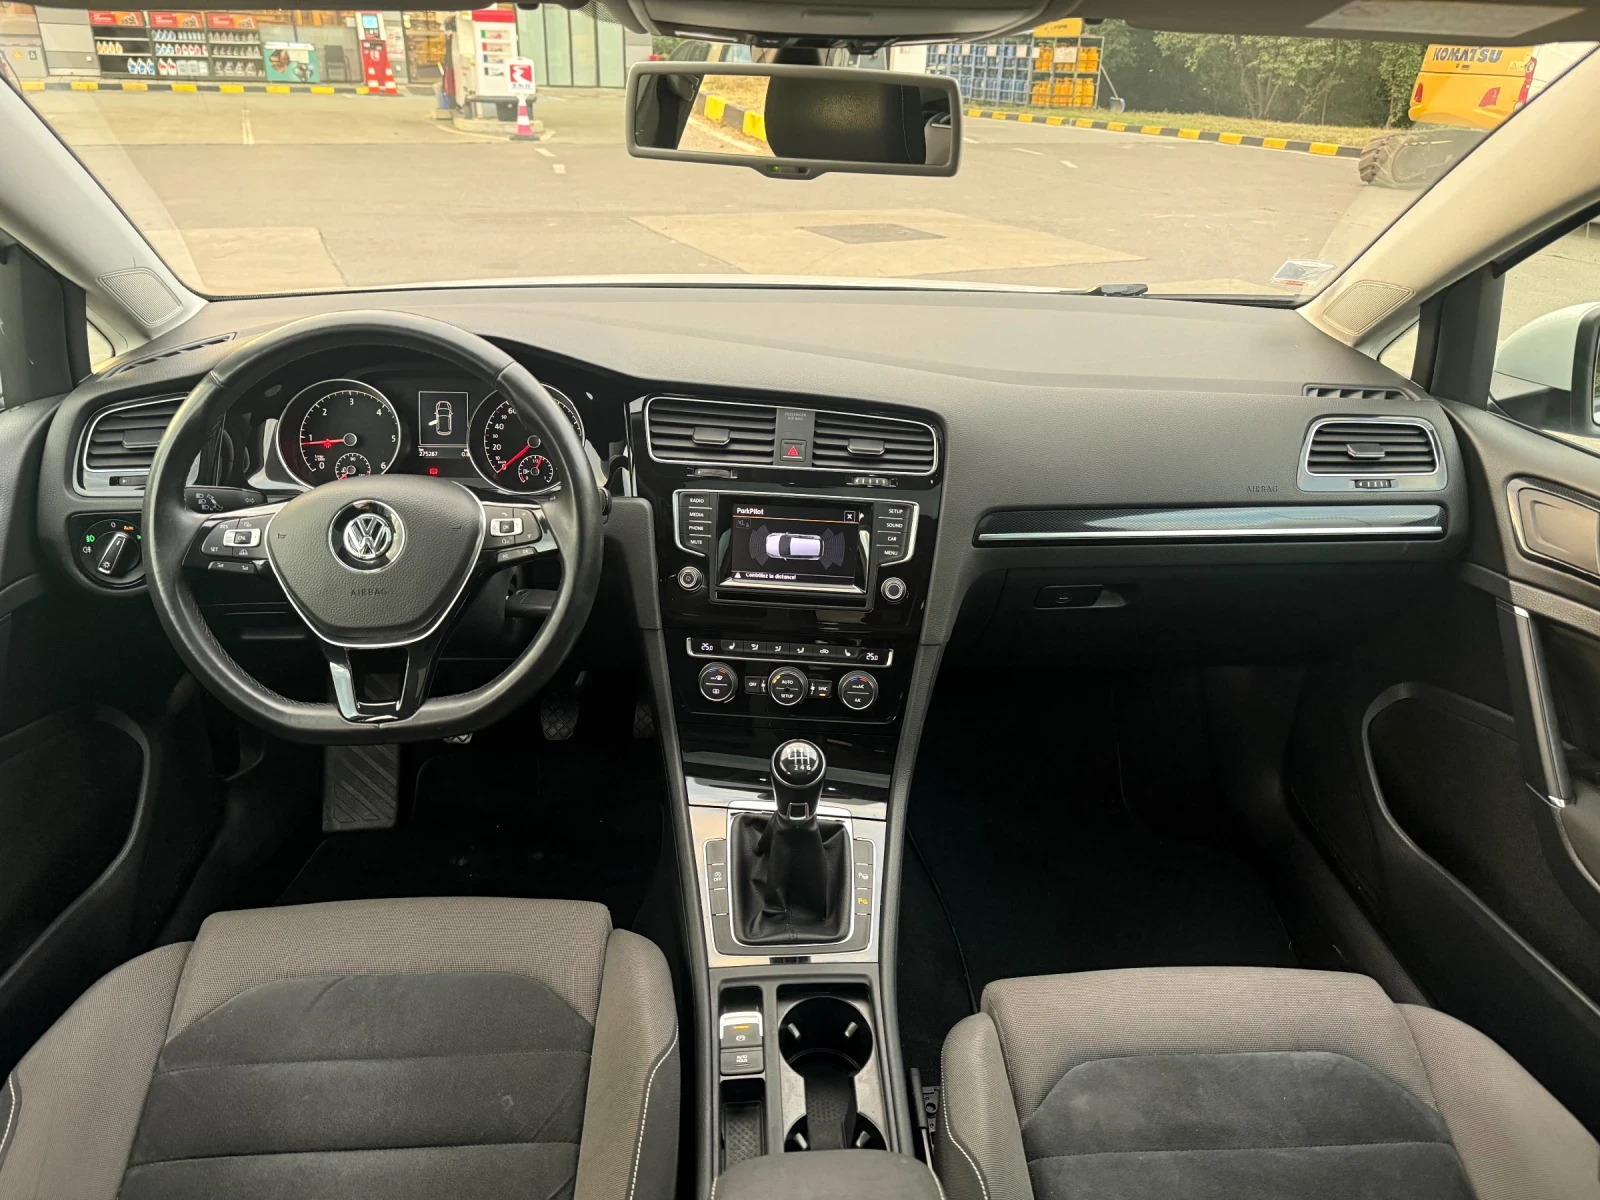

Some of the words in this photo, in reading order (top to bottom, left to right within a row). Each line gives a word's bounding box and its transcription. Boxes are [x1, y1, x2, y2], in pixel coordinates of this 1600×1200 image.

[1433, 48, 1503, 63] KOMATSU
[349, 398, 354, 406] 3
[318, 461, 325, 469] 0
[380, 461, 387, 469] 6
[736, 507, 764, 515] ParkPilot
[351, 588, 388, 597] AIRBAG
